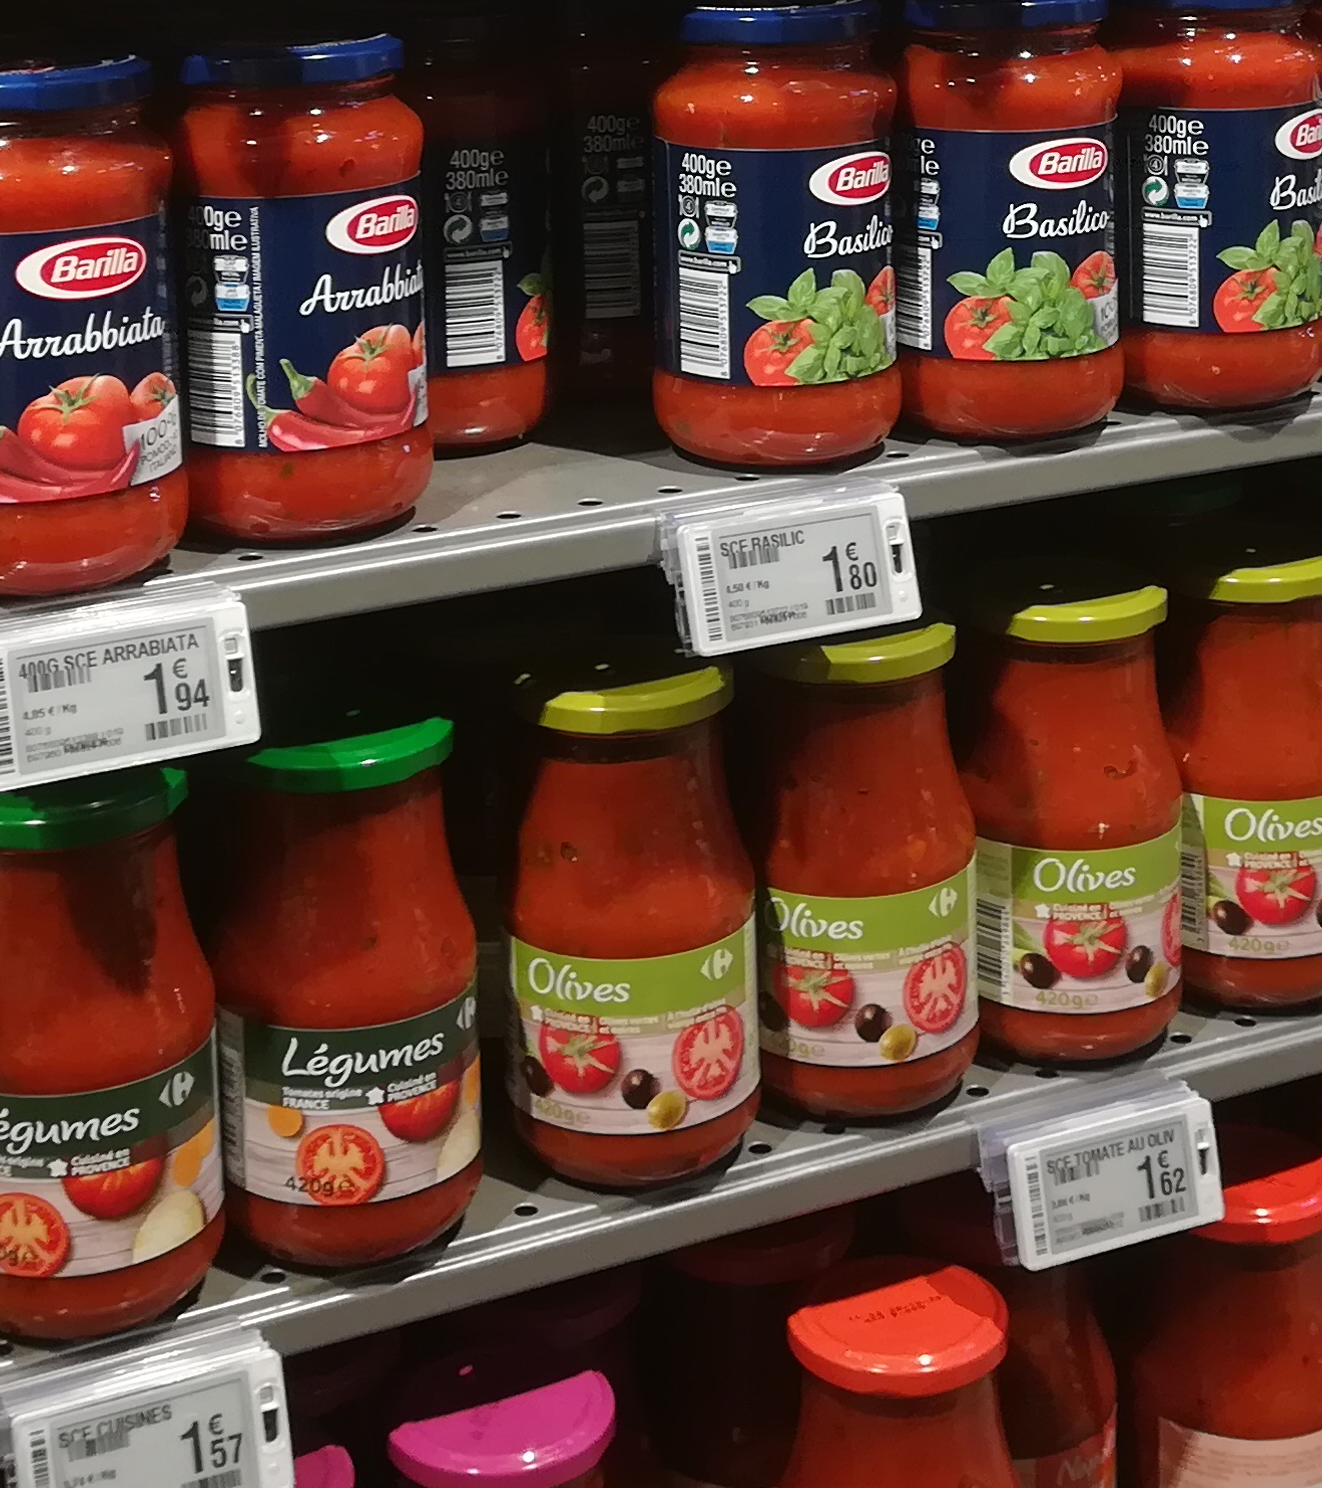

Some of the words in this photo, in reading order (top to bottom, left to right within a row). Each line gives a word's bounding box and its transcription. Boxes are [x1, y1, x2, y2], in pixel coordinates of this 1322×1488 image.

[1036, 147, 1103, 175] Barilla
[355, 208, 416, 239] Barilla
[1003, 202, 1108, 240] Basilico
[49, 248, 142, 284] Barilla
[103, 634, 199, 664] ARRABIATA
[1033, 858, 1136, 893] Olives
[527, 956, 631, 1004] Olives
[283, 1033, 444, 1084] Légumes
[1074, 1144, 1125, 1167] TOMATE
[1128, 1140, 1146, 1155] AU
[1148, 1130, 1175, 1151] OLIV
